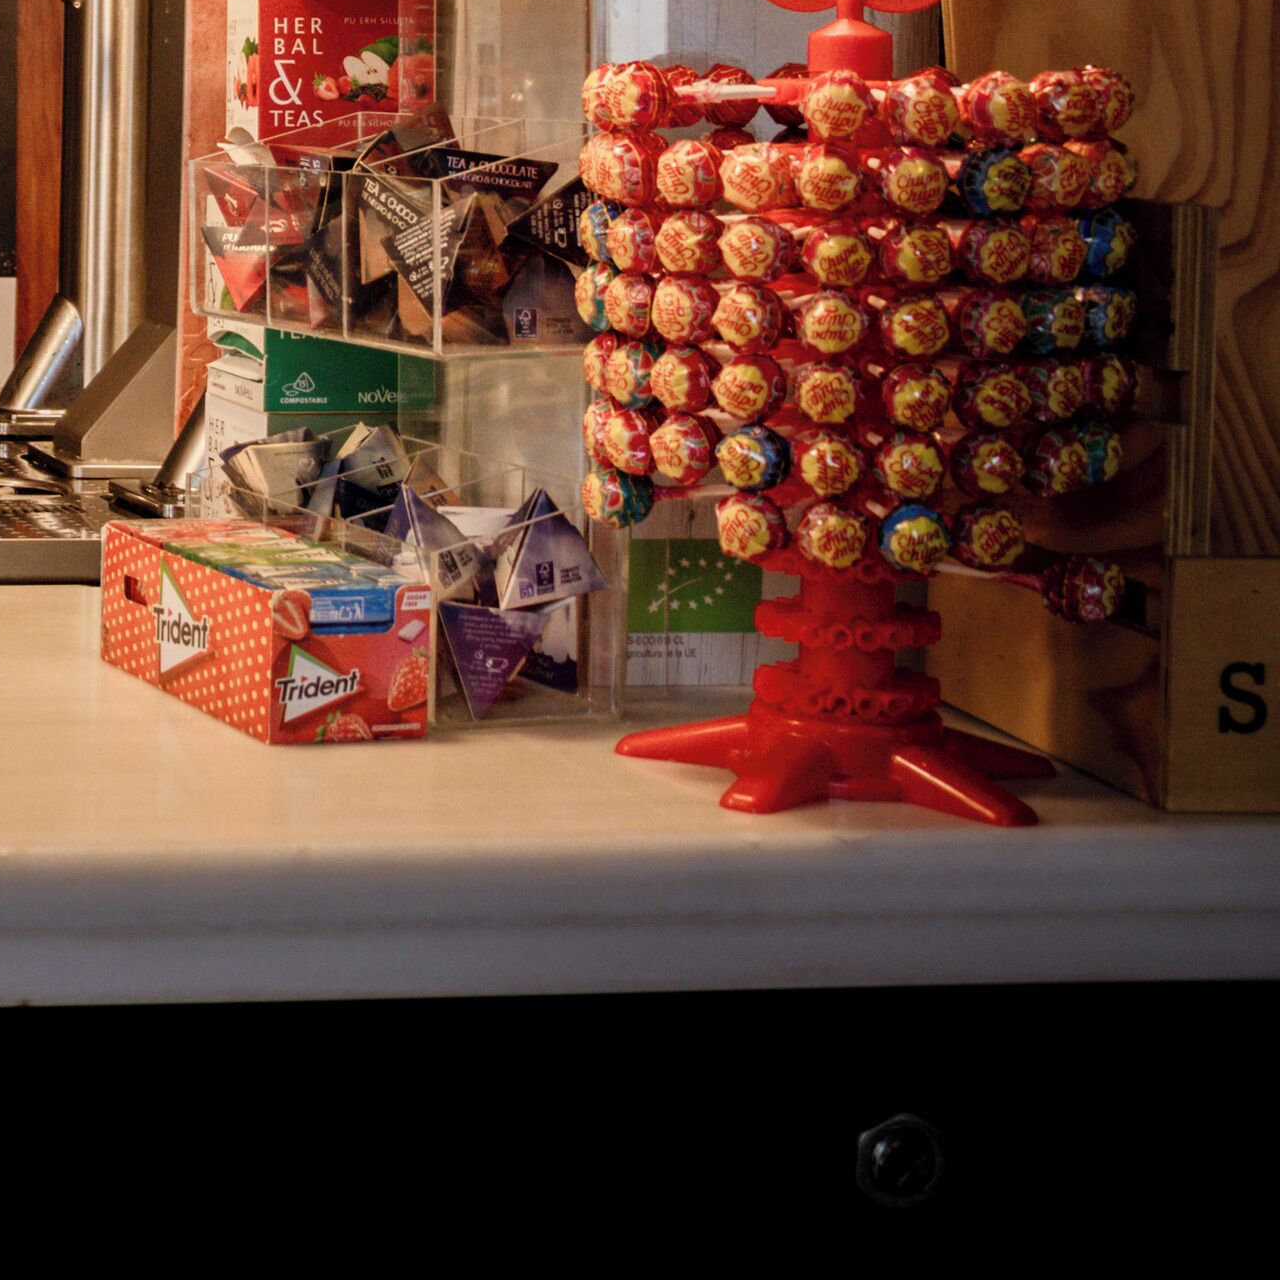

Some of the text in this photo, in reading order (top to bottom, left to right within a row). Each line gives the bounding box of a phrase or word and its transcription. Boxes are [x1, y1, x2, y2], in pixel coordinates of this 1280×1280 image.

[274, 17, 324, 35] HER
[274, 37, 324, 56] BAL
[268, 58, 304, 107] &
[816, 96, 862, 114] Chupa
[268, 109, 325, 129] TEAS
[811, 108, 858, 133] Chups
[446, 155, 469, 170] TEA
[483, 160, 539, 180] CHOCOLATE
[898, 170, 940, 189] Chupa
[363, 177, 380, 195] TEA
[387, 194, 419, 224] CHOCO
[803, 179, 848, 205] Chups
[280, 396, 328, 405] COMPOSTABLE
[897, 528, 938, 550] Chupa
[406, 593, 428, 602] SUGAR
[153, 607, 209, 650] Trident
[276, 670, 360, 705] Trident
[1217, 662, 1268, 734] S
